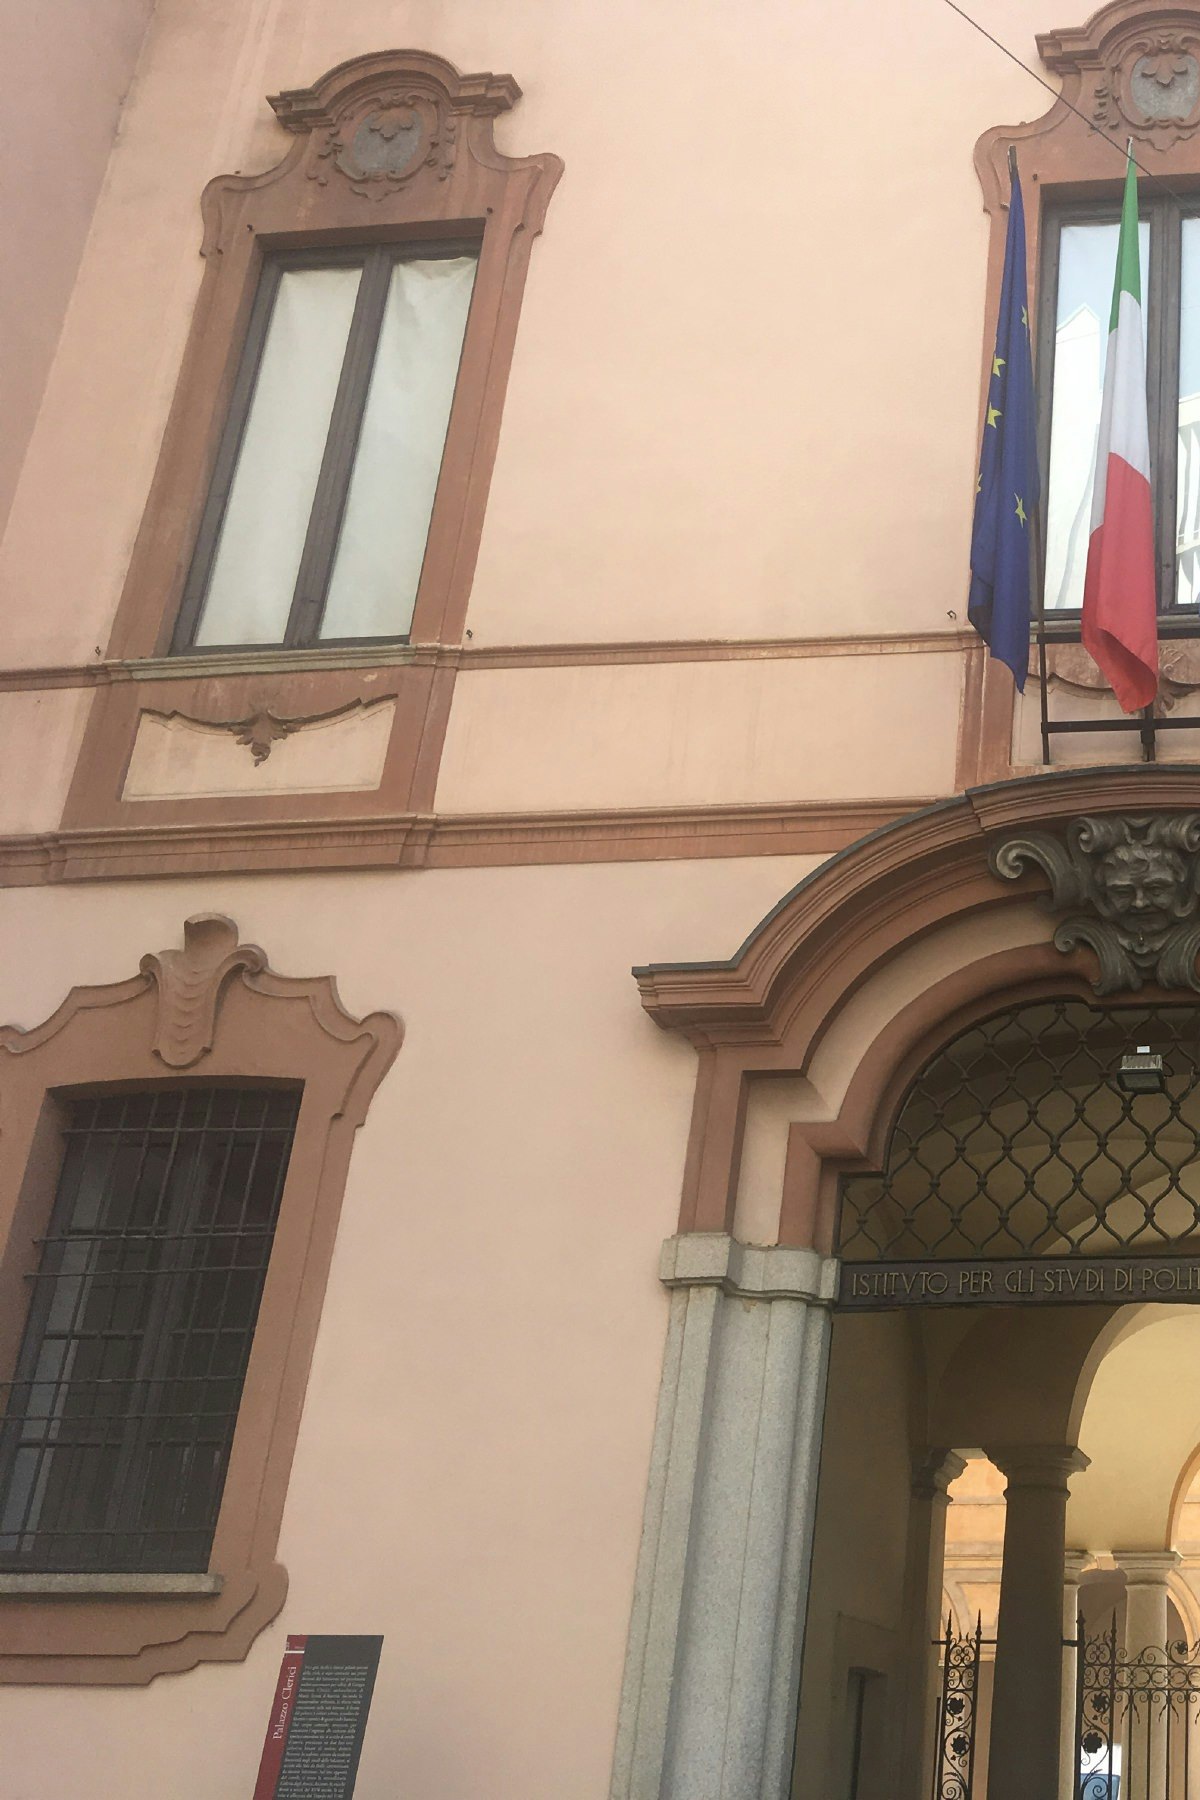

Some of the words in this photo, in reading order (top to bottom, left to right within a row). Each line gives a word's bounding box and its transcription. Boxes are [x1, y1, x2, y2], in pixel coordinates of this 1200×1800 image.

[852, 1271, 948, 1296] ISTITVTO
[959, 1270, 994, 1294] PER
[1004, 1268, 1035, 1294] GLI
[1044, 1268, 1105, 1293] STVDI
[1115, 1267, 1134, 1293] DI
[273, 1703, 288, 1740] Palazzo
[281, 1666, 297, 1700] Clerici
